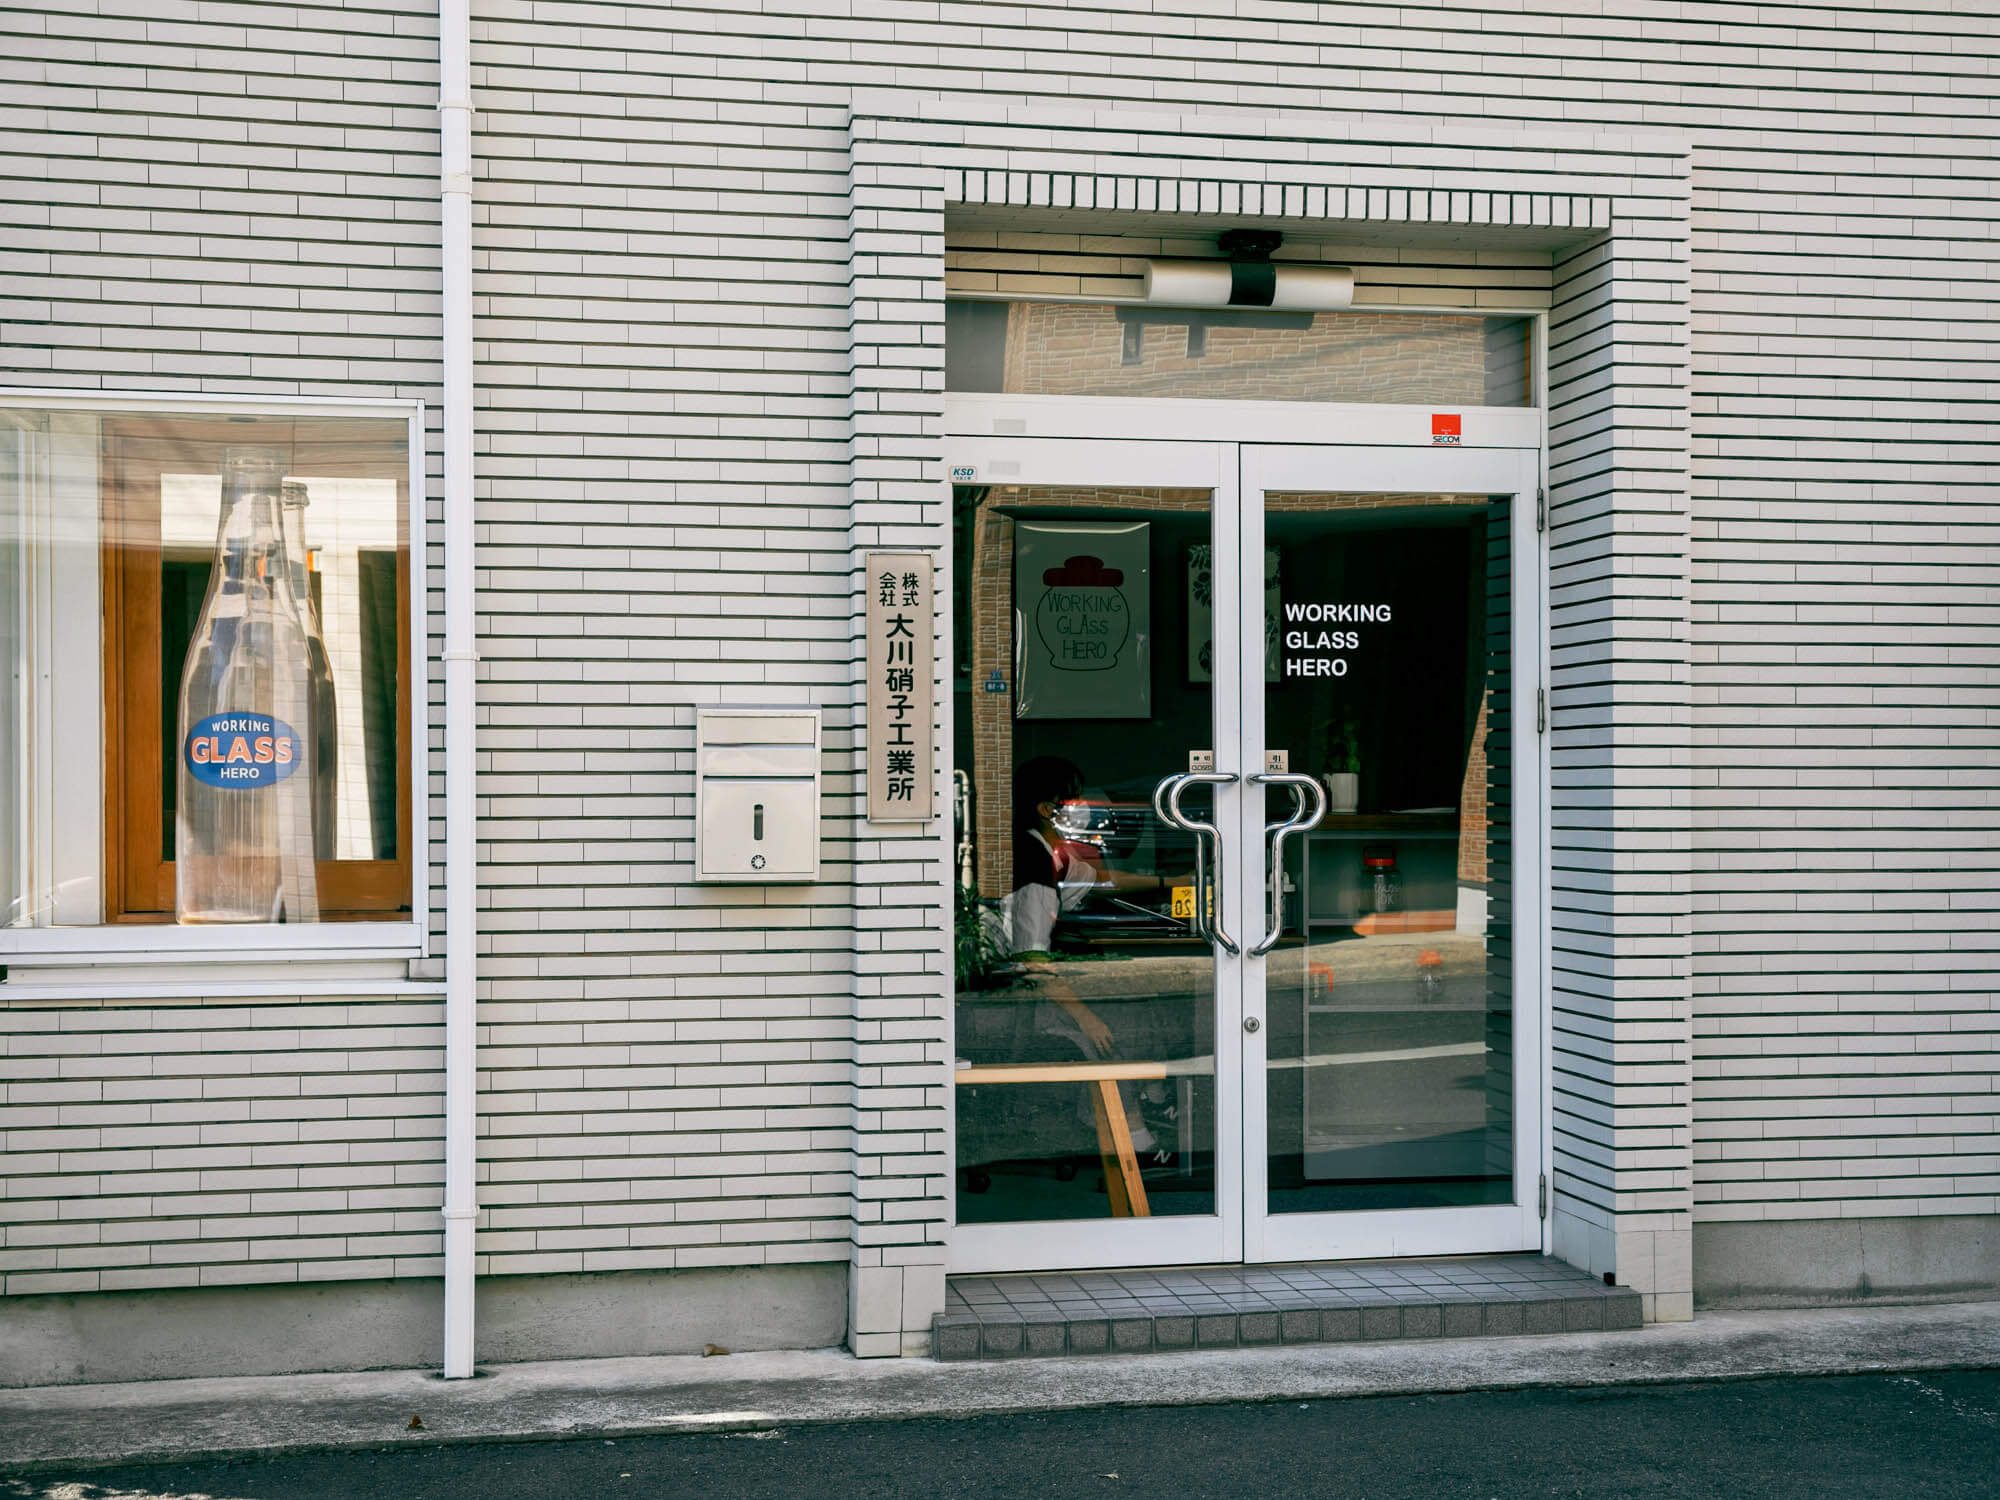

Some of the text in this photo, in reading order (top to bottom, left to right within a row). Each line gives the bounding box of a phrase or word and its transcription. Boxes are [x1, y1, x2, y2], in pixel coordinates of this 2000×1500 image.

[1432, 435, 1460, 443] SECOM
[953, 468, 975, 476] KSD
[1047, 592, 1122, 612] WORKING
[1285, 603, 1392, 622] WORKING
[1286, 631, 1359, 649] GLASS
[1062, 640, 1107, 659] HERO
[1286, 658, 1348, 676] HERO
[886, 613, 914, 801] 大川硝子工業所
[211, 719, 270, 732] WORKING
[191, 736, 293, 764] GLASS
[220, 767, 260, 779] HERO
